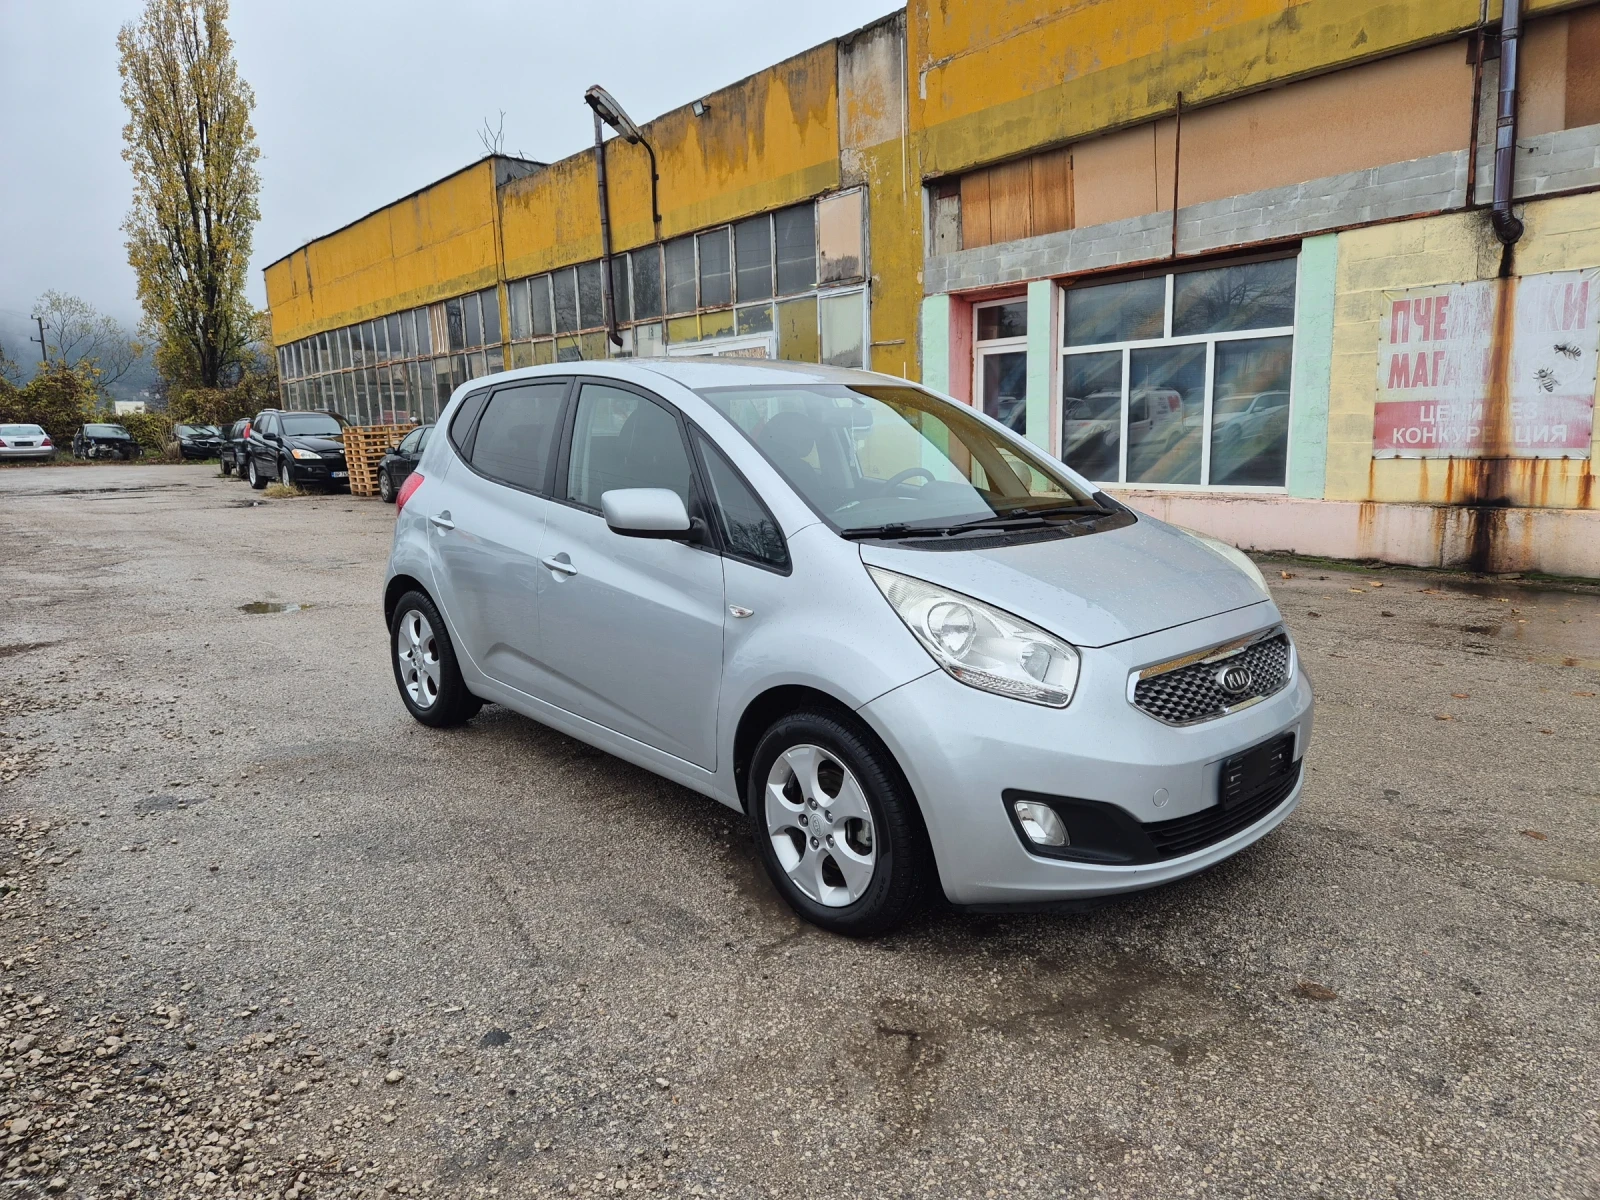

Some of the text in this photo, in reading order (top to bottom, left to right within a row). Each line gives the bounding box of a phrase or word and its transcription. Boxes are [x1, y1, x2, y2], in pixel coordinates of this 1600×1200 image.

[1420, 404, 1482, 424] ЦЕНИ
[1392, 425, 1568, 446] КОНКУРЕЦИЯ
[1226, 670, 1249, 689] KIA
